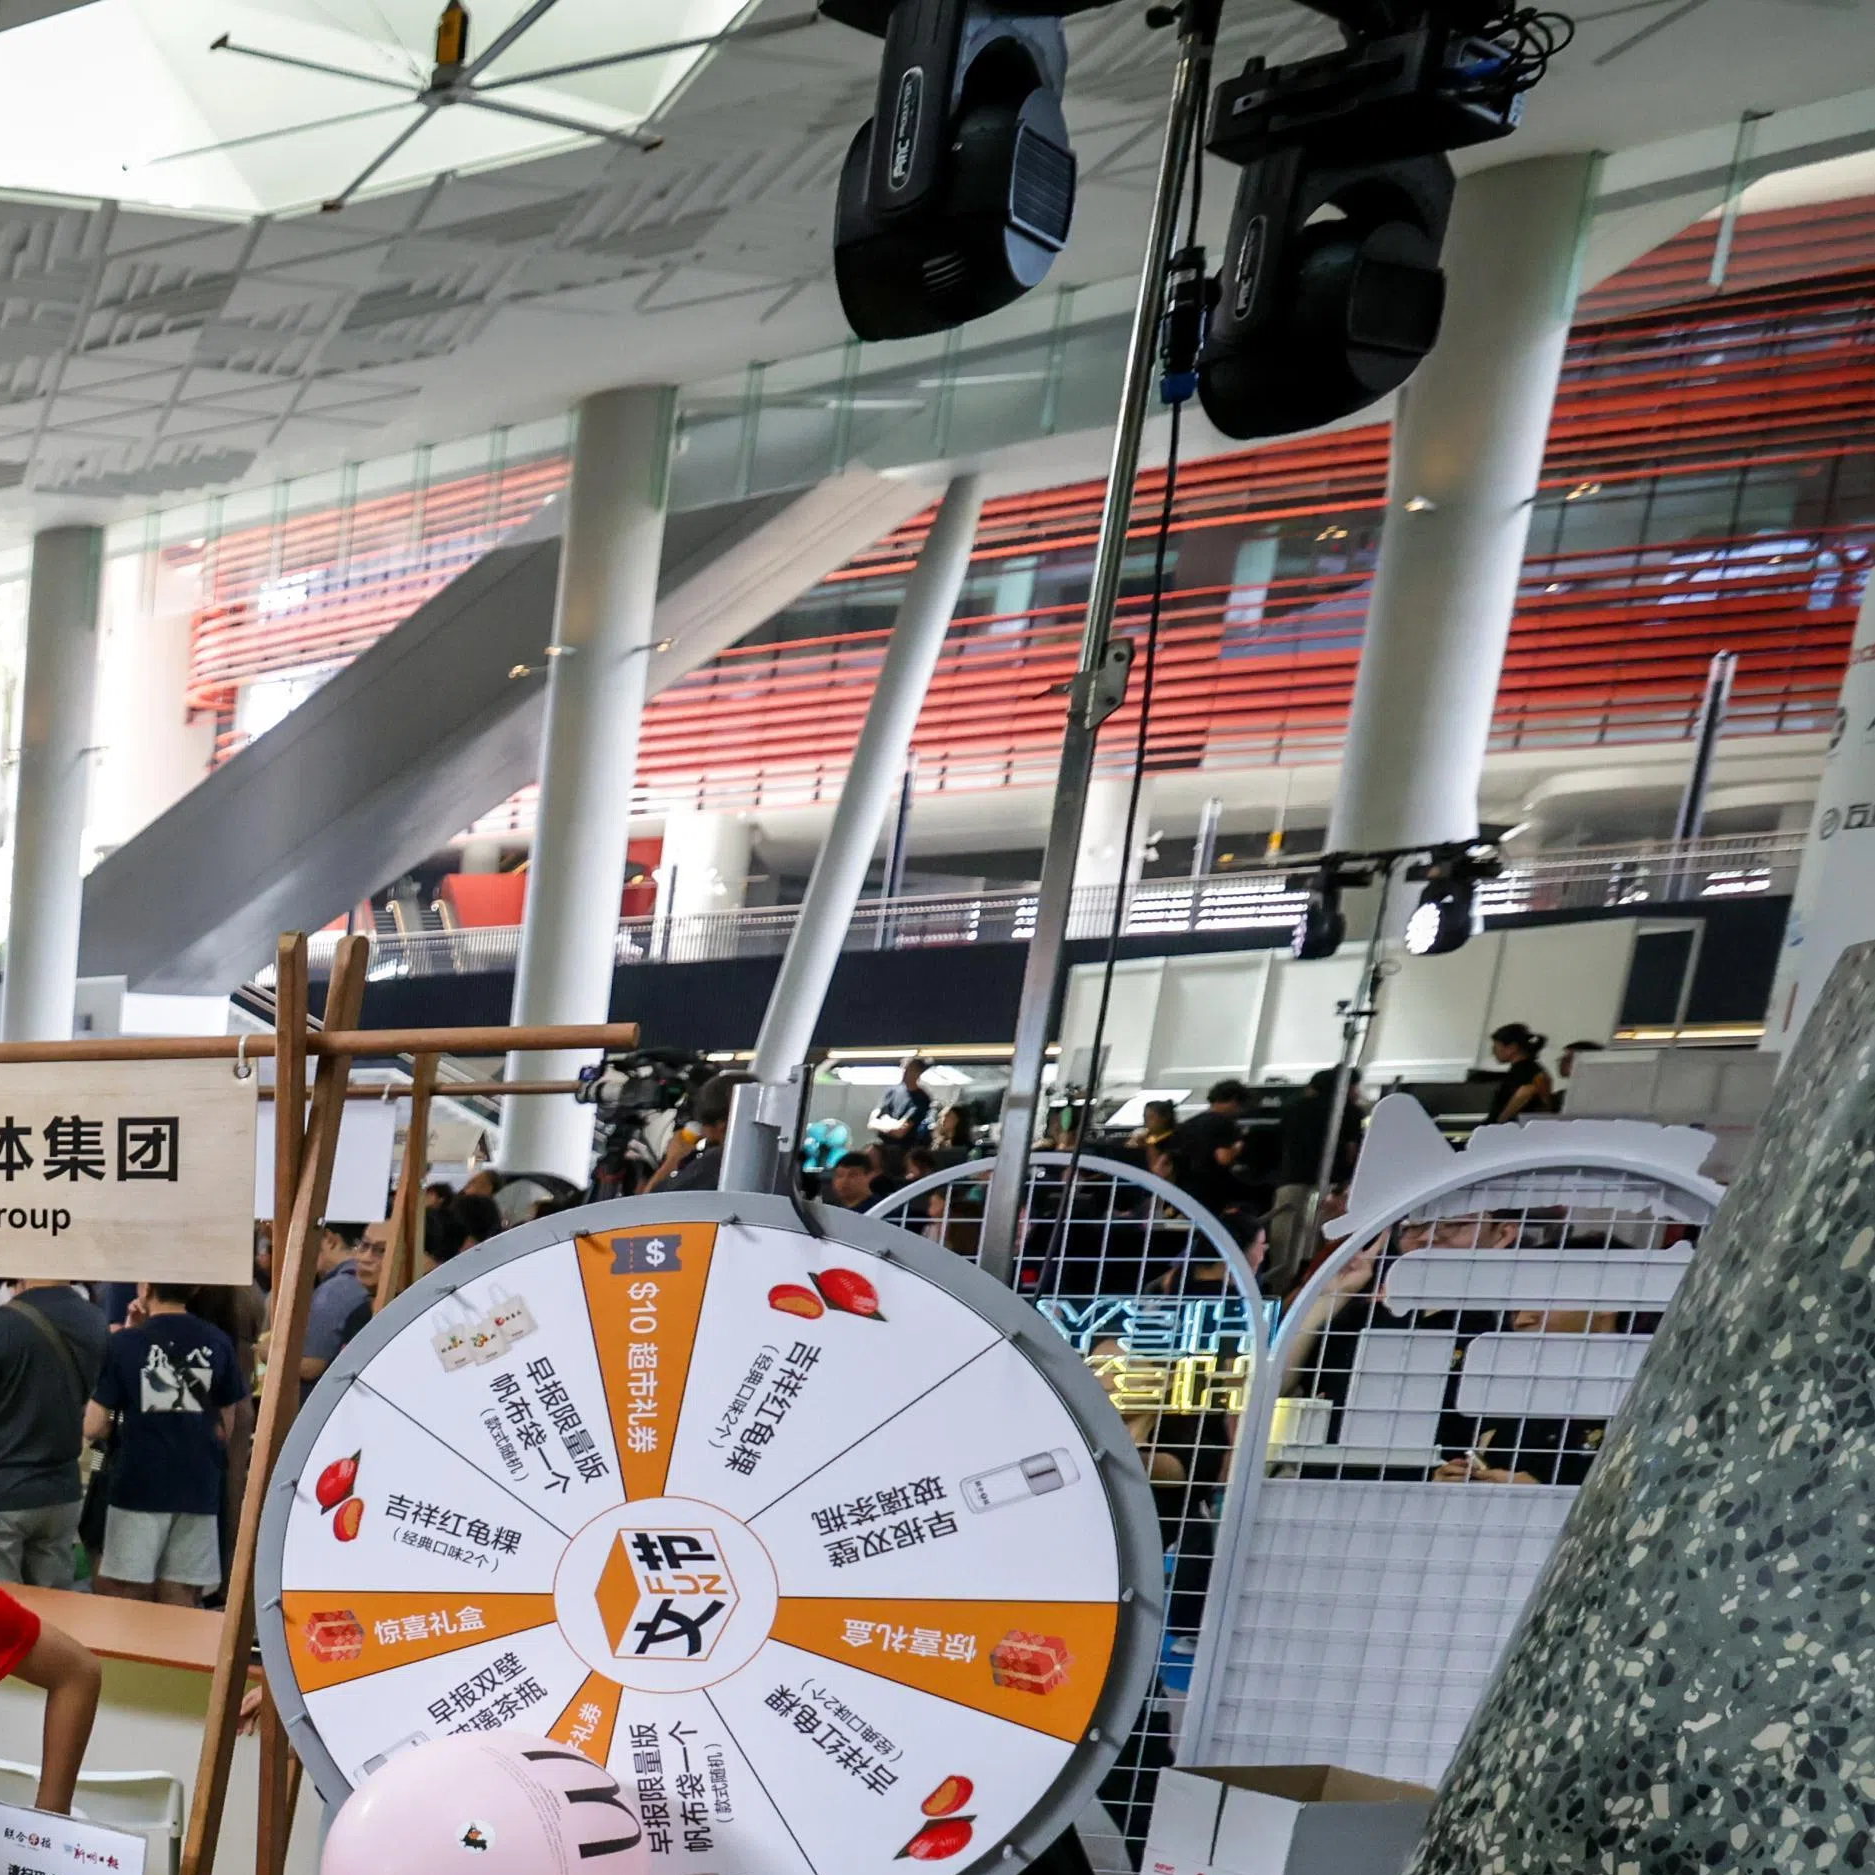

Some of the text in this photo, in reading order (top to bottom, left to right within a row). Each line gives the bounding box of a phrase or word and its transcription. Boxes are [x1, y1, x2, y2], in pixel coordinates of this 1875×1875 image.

[627, 1281, 661, 1454] $10 超市礼券
[489, 1372, 571, 1494] 帆布袋一个
[526, 1356, 609, 1484] 早报限量版
[724, 1341, 821, 1476] 吉祥红龟粿
[385, 1493, 522, 1555] 吉祥红龟粿
[811, 1475, 948, 1536] 玻璃茶瓶
[823, 1510, 959, 1569] 早报双壁
[632, 1532, 717, 1572] 节
[644, 1574, 728, 1596] FUN
[374, 1605, 486, 1646] 惊喜礼盒
[634, 1599, 725, 1656] 文
[841, 1618, 977, 1663] 惊喜礼盒
[427, 1651, 527, 1726] 早报双壁
[765, 1684, 899, 1795] 吉祥红龟粿
[629, 1722, 675, 1855] 早报限量版
[668, 1720, 715, 1854] 帆布袋一个
